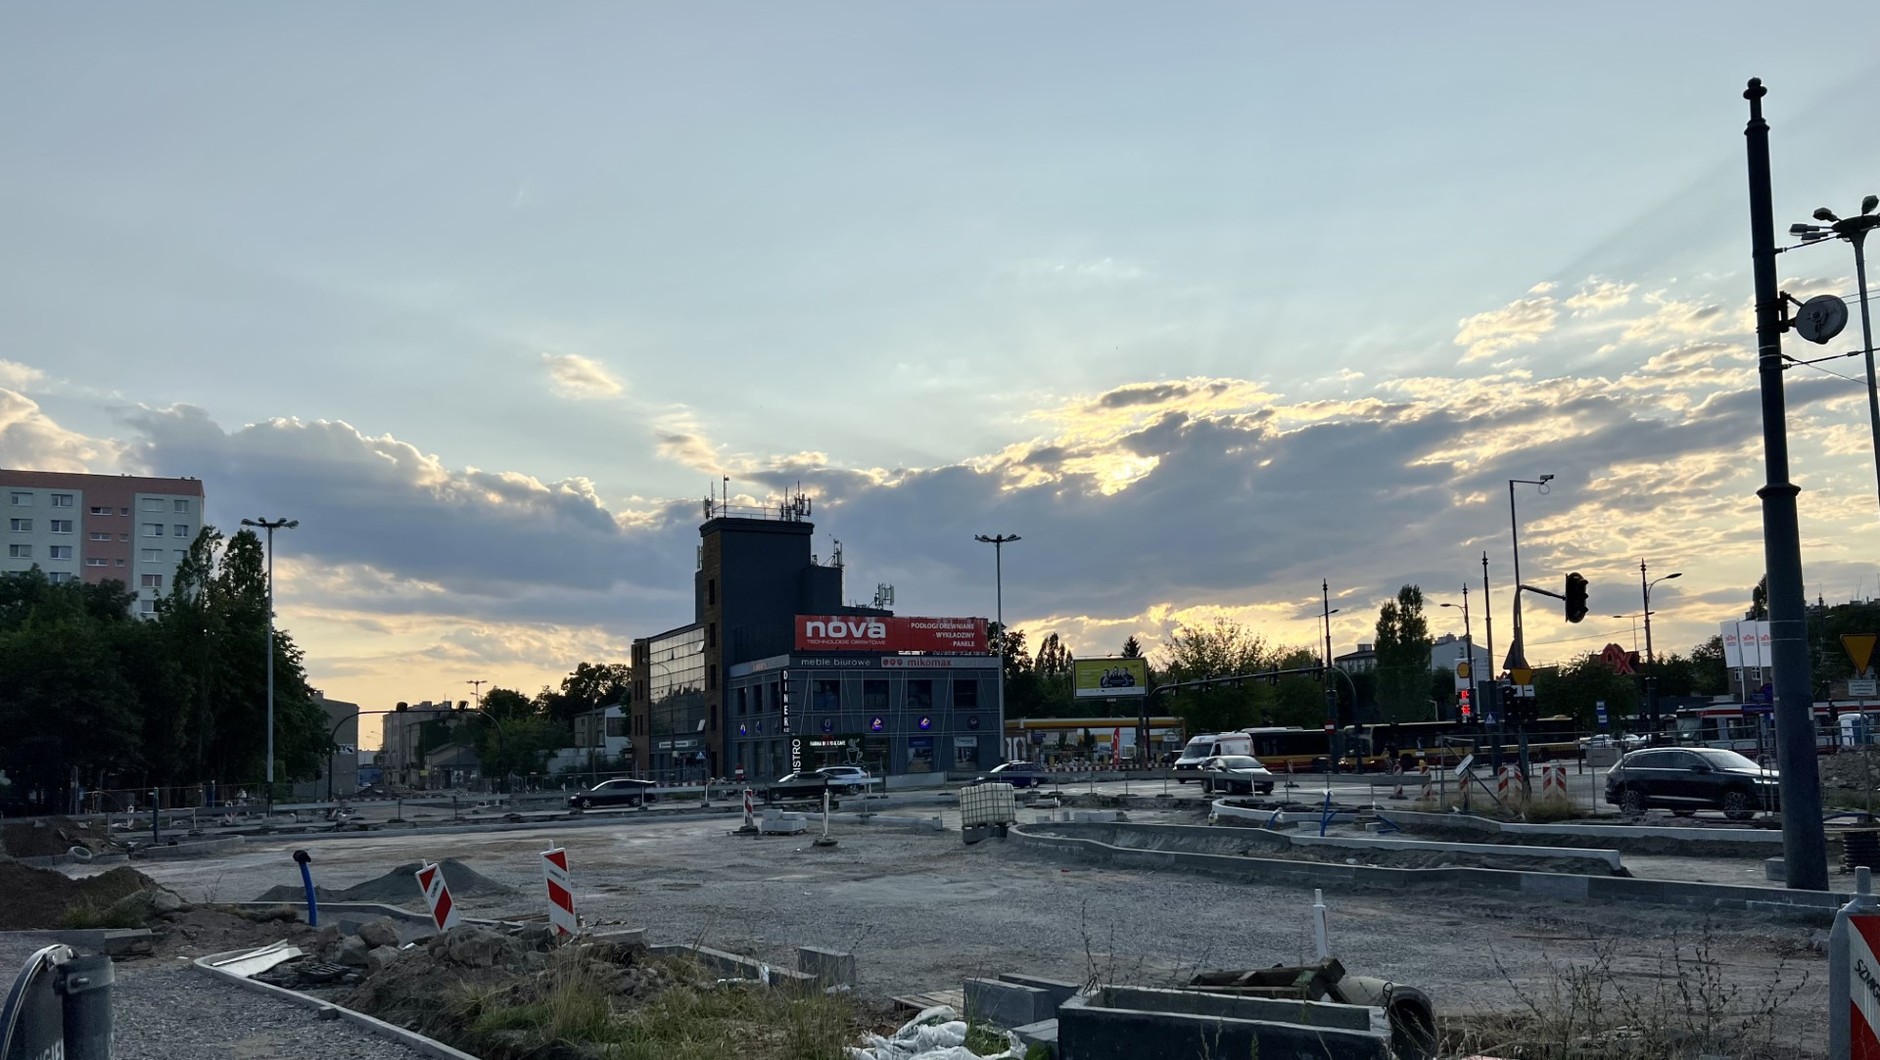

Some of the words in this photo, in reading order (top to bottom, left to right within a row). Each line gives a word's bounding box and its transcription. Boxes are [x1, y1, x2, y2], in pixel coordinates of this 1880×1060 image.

[806, 621, 886, 638] nova
[911, 622, 939, 630] PODŁOGI
[801, 658, 831, 666] meble
[833, 658, 871, 666] biurowe
[907, 658, 952, 667] mikomax
